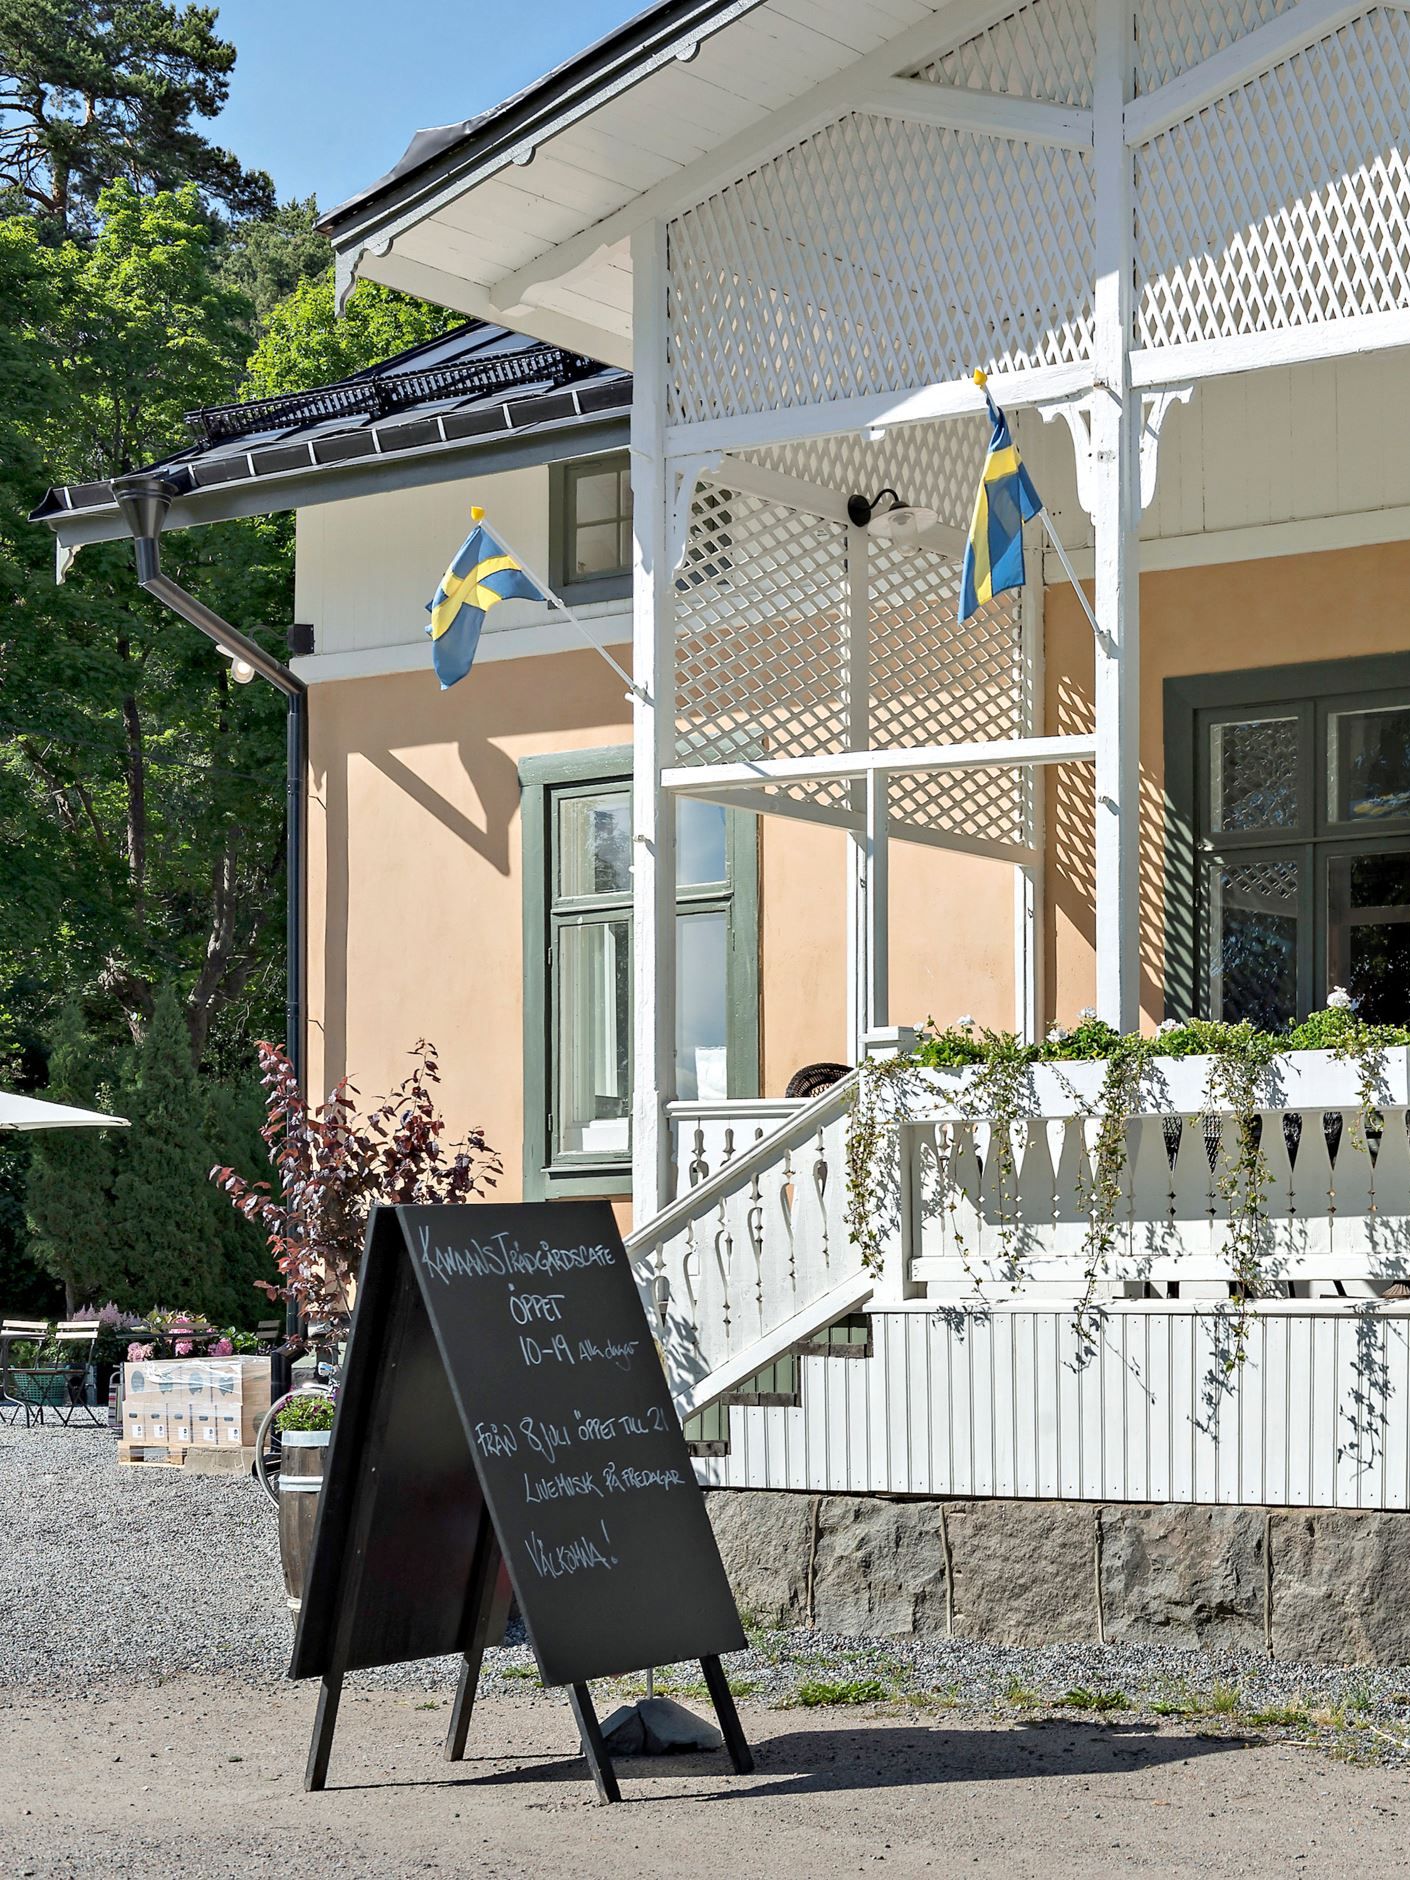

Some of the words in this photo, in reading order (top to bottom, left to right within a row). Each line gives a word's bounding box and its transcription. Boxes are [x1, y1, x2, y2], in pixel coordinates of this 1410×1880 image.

[508, 1283, 565, 1325] ÖPPET
[519, 1334, 576, 1366] 10-19
[579, 1339, 604, 1361] Alla
[475, 1422, 518, 1457] FRÅN
[519, 1416, 542, 1451] 8
[540, 1422, 571, 1464] JULI
[573, 1409, 616, 1441] ÖPPET
[618, 1416, 649, 1434] TILL
[646, 1406, 669, 1432] 21
[523, 1471, 604, 1503] LIVEMUSIK
[603, 1461, 626, 1493] PÅ
[621, 1467, 686, 1491] FREDAGAR
